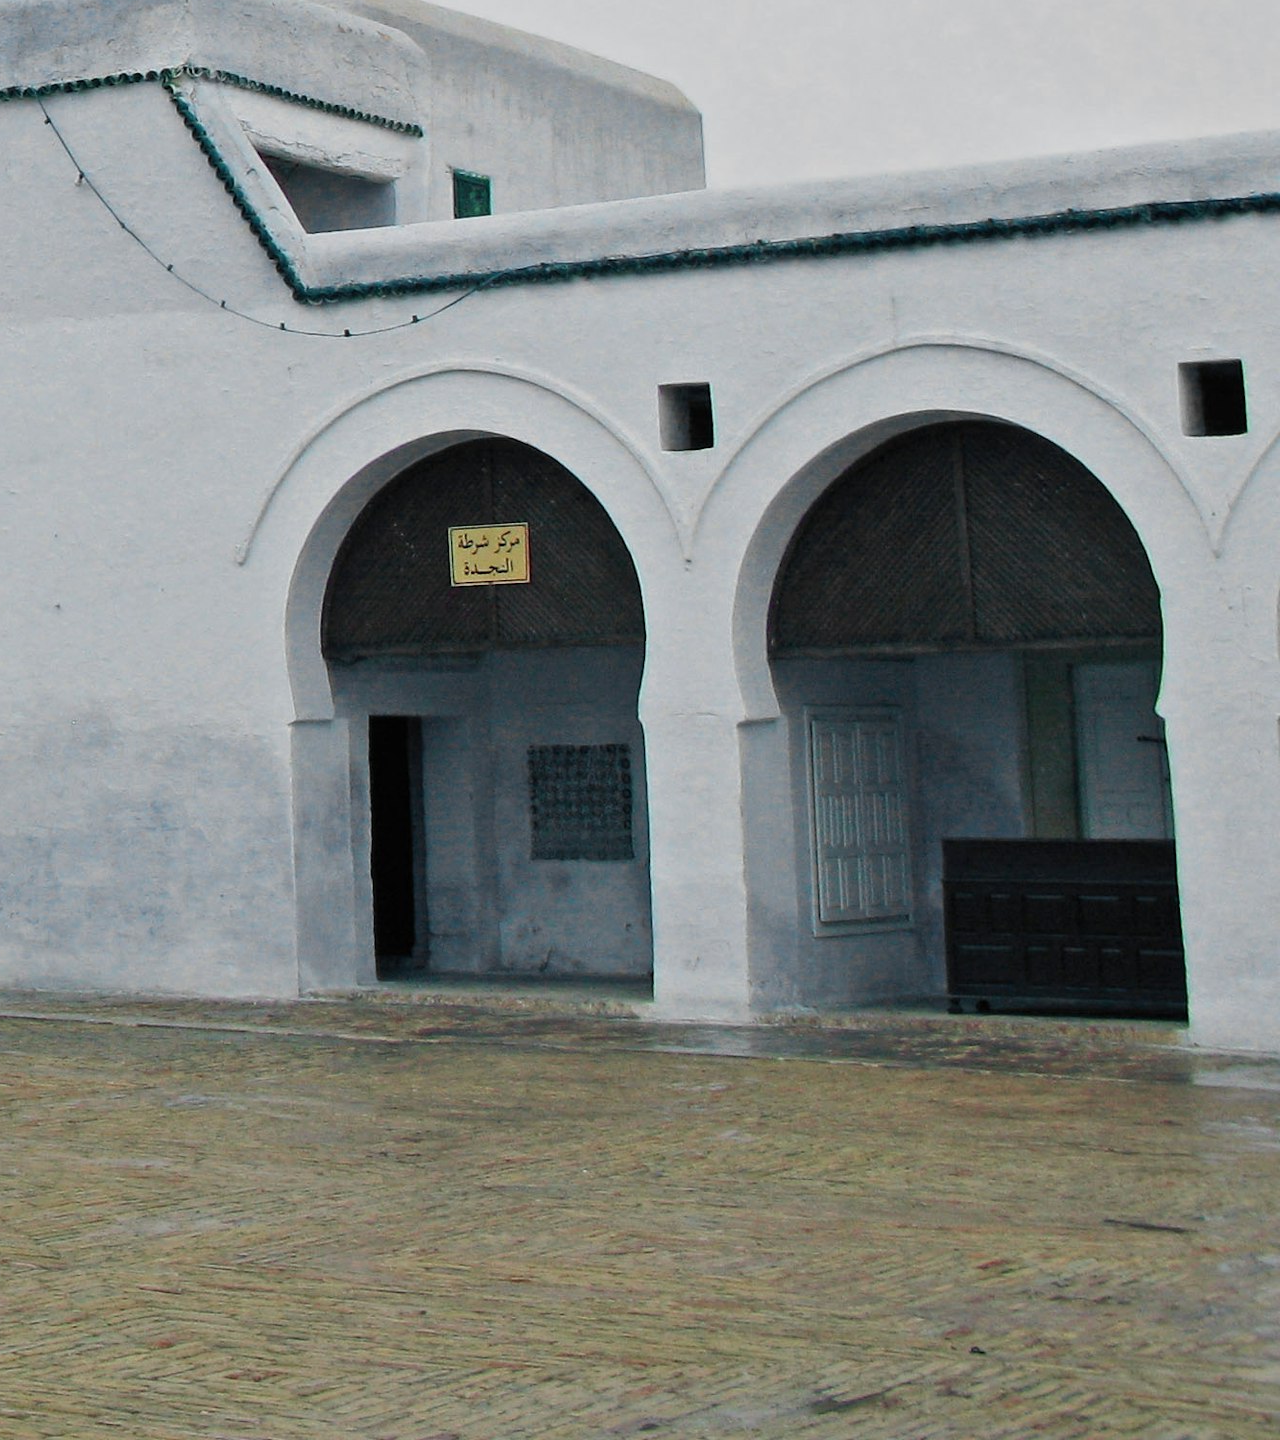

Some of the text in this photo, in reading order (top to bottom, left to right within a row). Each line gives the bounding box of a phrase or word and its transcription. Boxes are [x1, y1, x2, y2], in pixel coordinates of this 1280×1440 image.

[458, 531, 520, 555] مركز شرطة
[464, 558, 513, 576] النجدة
